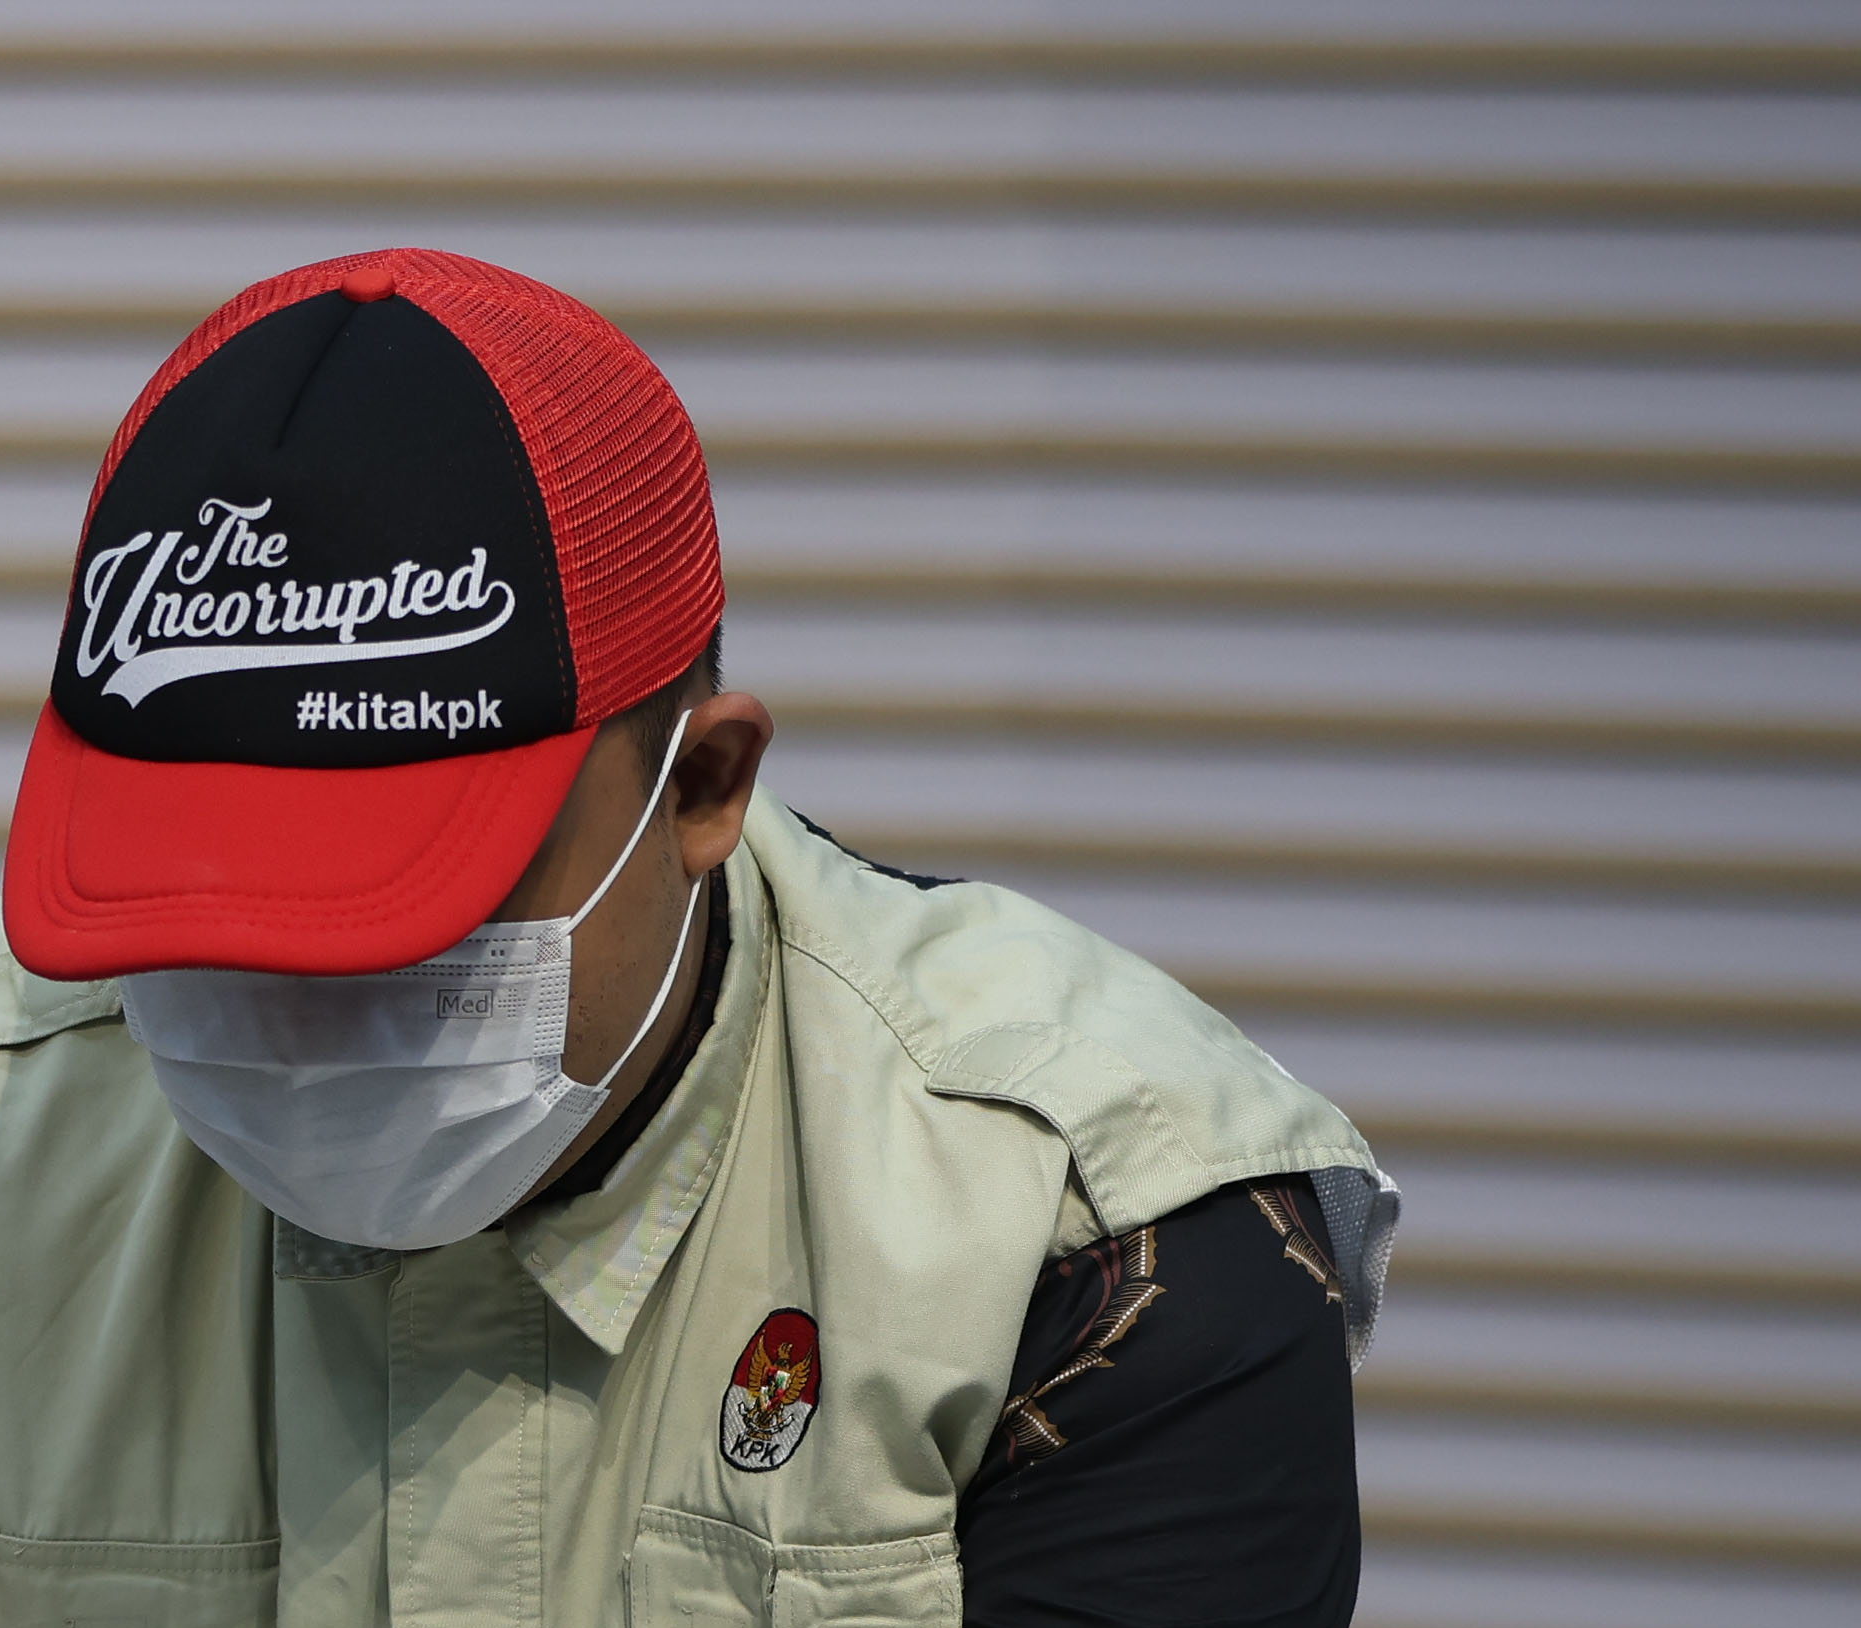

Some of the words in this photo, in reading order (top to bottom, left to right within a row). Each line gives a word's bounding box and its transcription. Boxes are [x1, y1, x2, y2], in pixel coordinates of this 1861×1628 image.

[176, 497, 288, 585] The
[76, 532, 516, 709] Uncorrupted
[297, 690, 503, 739] #kitakpk
[441, 995, 489, 1014] Med
[730, 1433, 782, 1465] KPK
